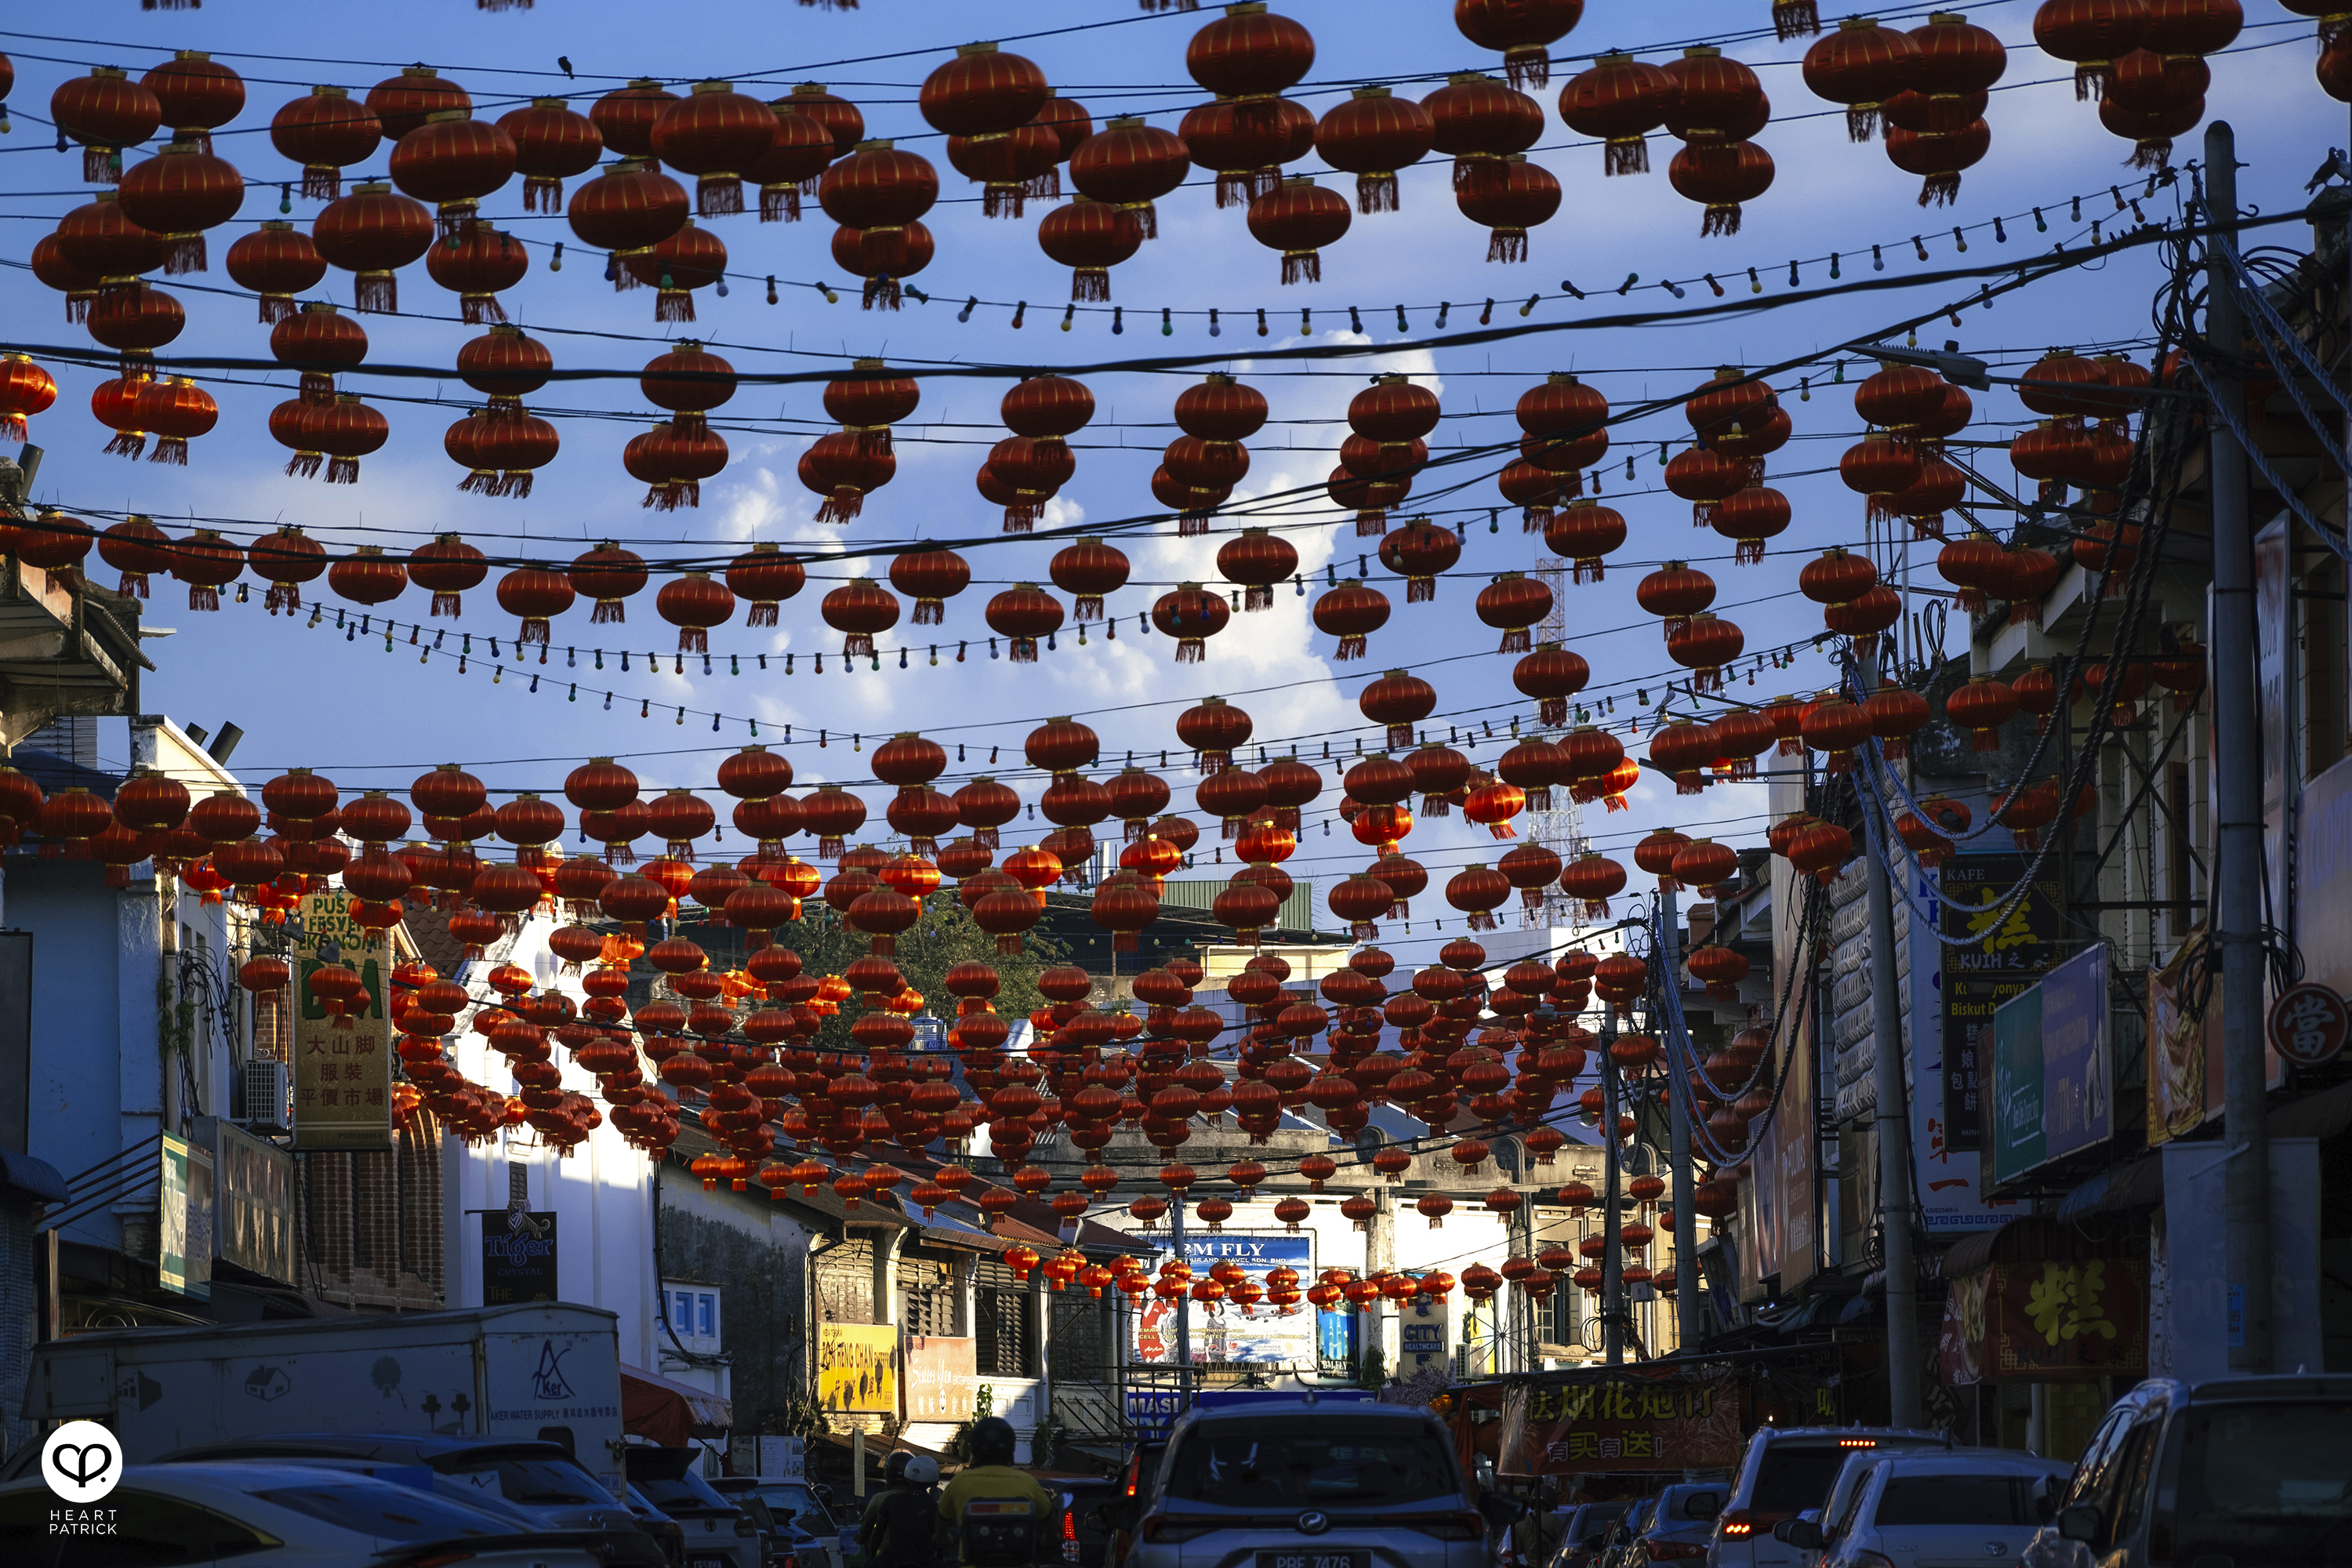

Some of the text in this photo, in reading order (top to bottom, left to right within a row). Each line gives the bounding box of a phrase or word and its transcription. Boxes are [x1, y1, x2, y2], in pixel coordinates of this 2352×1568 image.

[1946, 869, 1985, 881] KAFE
[1960, 953, 2002, 969] KUIH
[1951, 1003, 1985, 1016] Biskut
[2283, 994, 2336, 1058] 當
[307, 1035, 375, 1055] 大山脚
[320, 1062, 363, 1081] 服裝
[299, 1087, 384, 1106] 平價市場
[485, 1232, 554, 1267] Tiger
[1221, 1243, 1265, 1256] FLY
[497, 1268, 543, 1276] CRYSTAL
[1403, 1324, 1443, 1341] CITY
[855, 1343, 873, 1369] CHAN
[2017, 1345, 2068, 1365] KUIH
[911, 1357, 936, 1389] Sisters
[490, 1412, 509, 1421] AKER
[510, 1410, 532, 1420] WATER
[535, 1410, 560, 1420] SUPPLY
